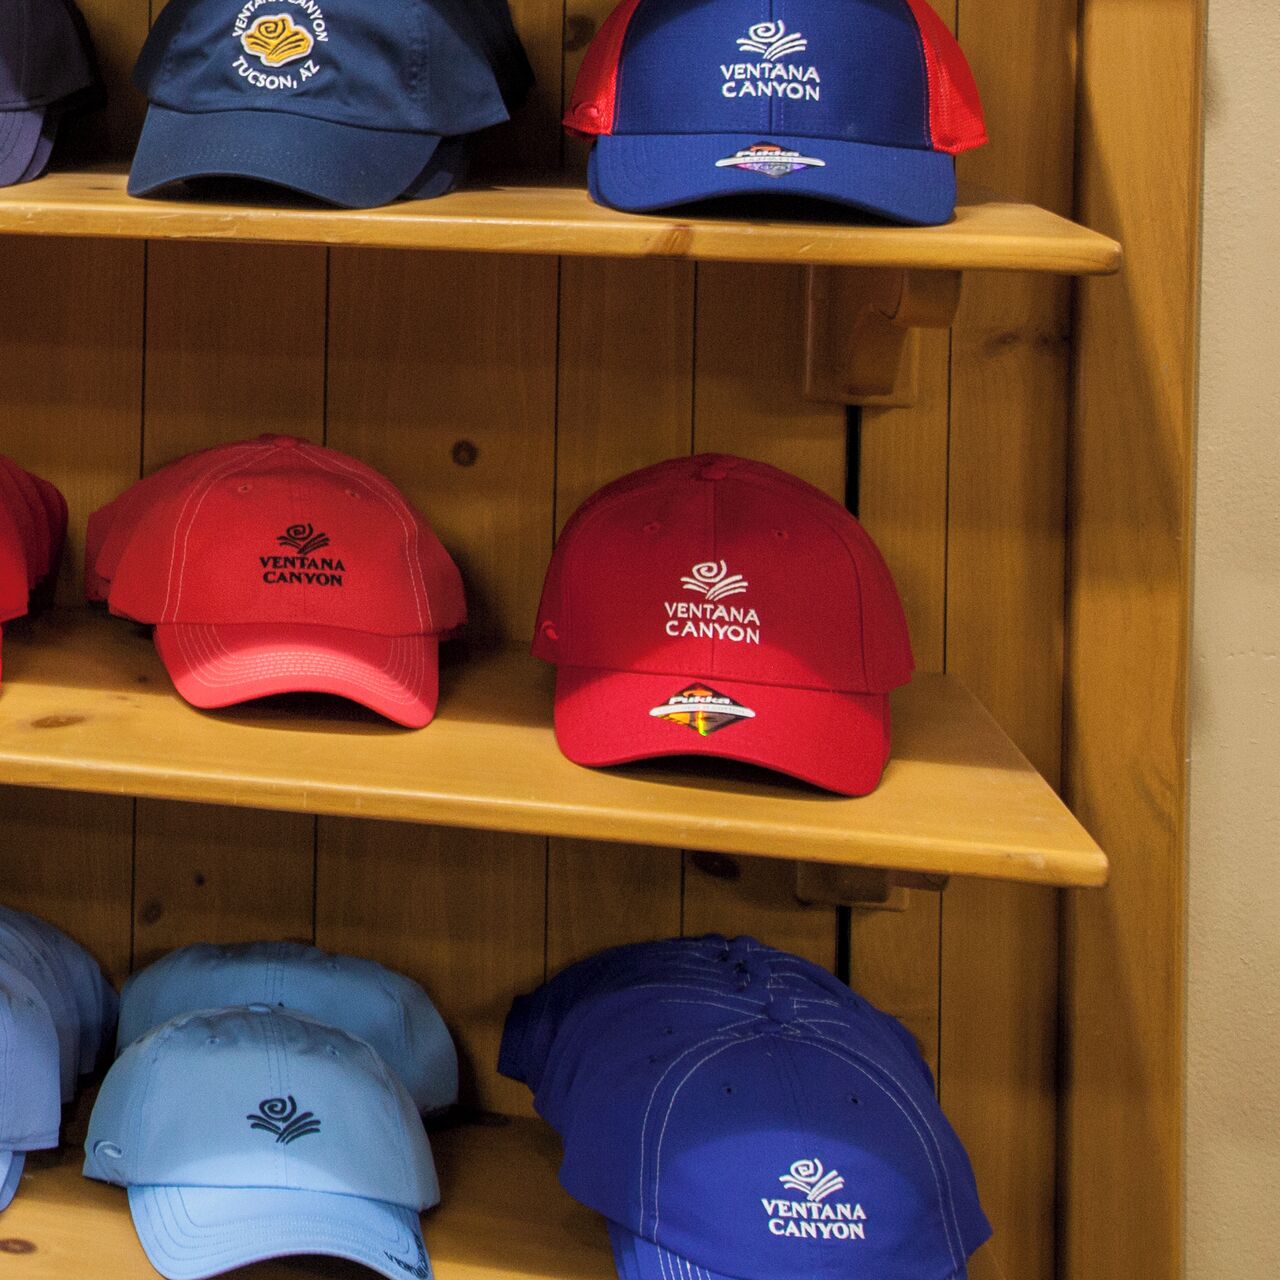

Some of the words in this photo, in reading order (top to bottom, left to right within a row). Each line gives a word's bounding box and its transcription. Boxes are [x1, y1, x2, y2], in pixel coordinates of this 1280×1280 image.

[232, 56, 297, 89] TUCSON,
[299, 59, 320, 82] AZ
[720, 63, 820, 83] VENTANA
[722, 81, 820, 101] CANYON
[260, 556, 346, 572] VENTANA
[263, 571, 343, 587] CANYON
[664, 601, 760, 626] VENTANA
[665, 620, 760, 645] CANYON
[761, 1198, 867, 1220] VENTANA
[768, 1218, 866, 1240] CANYON
